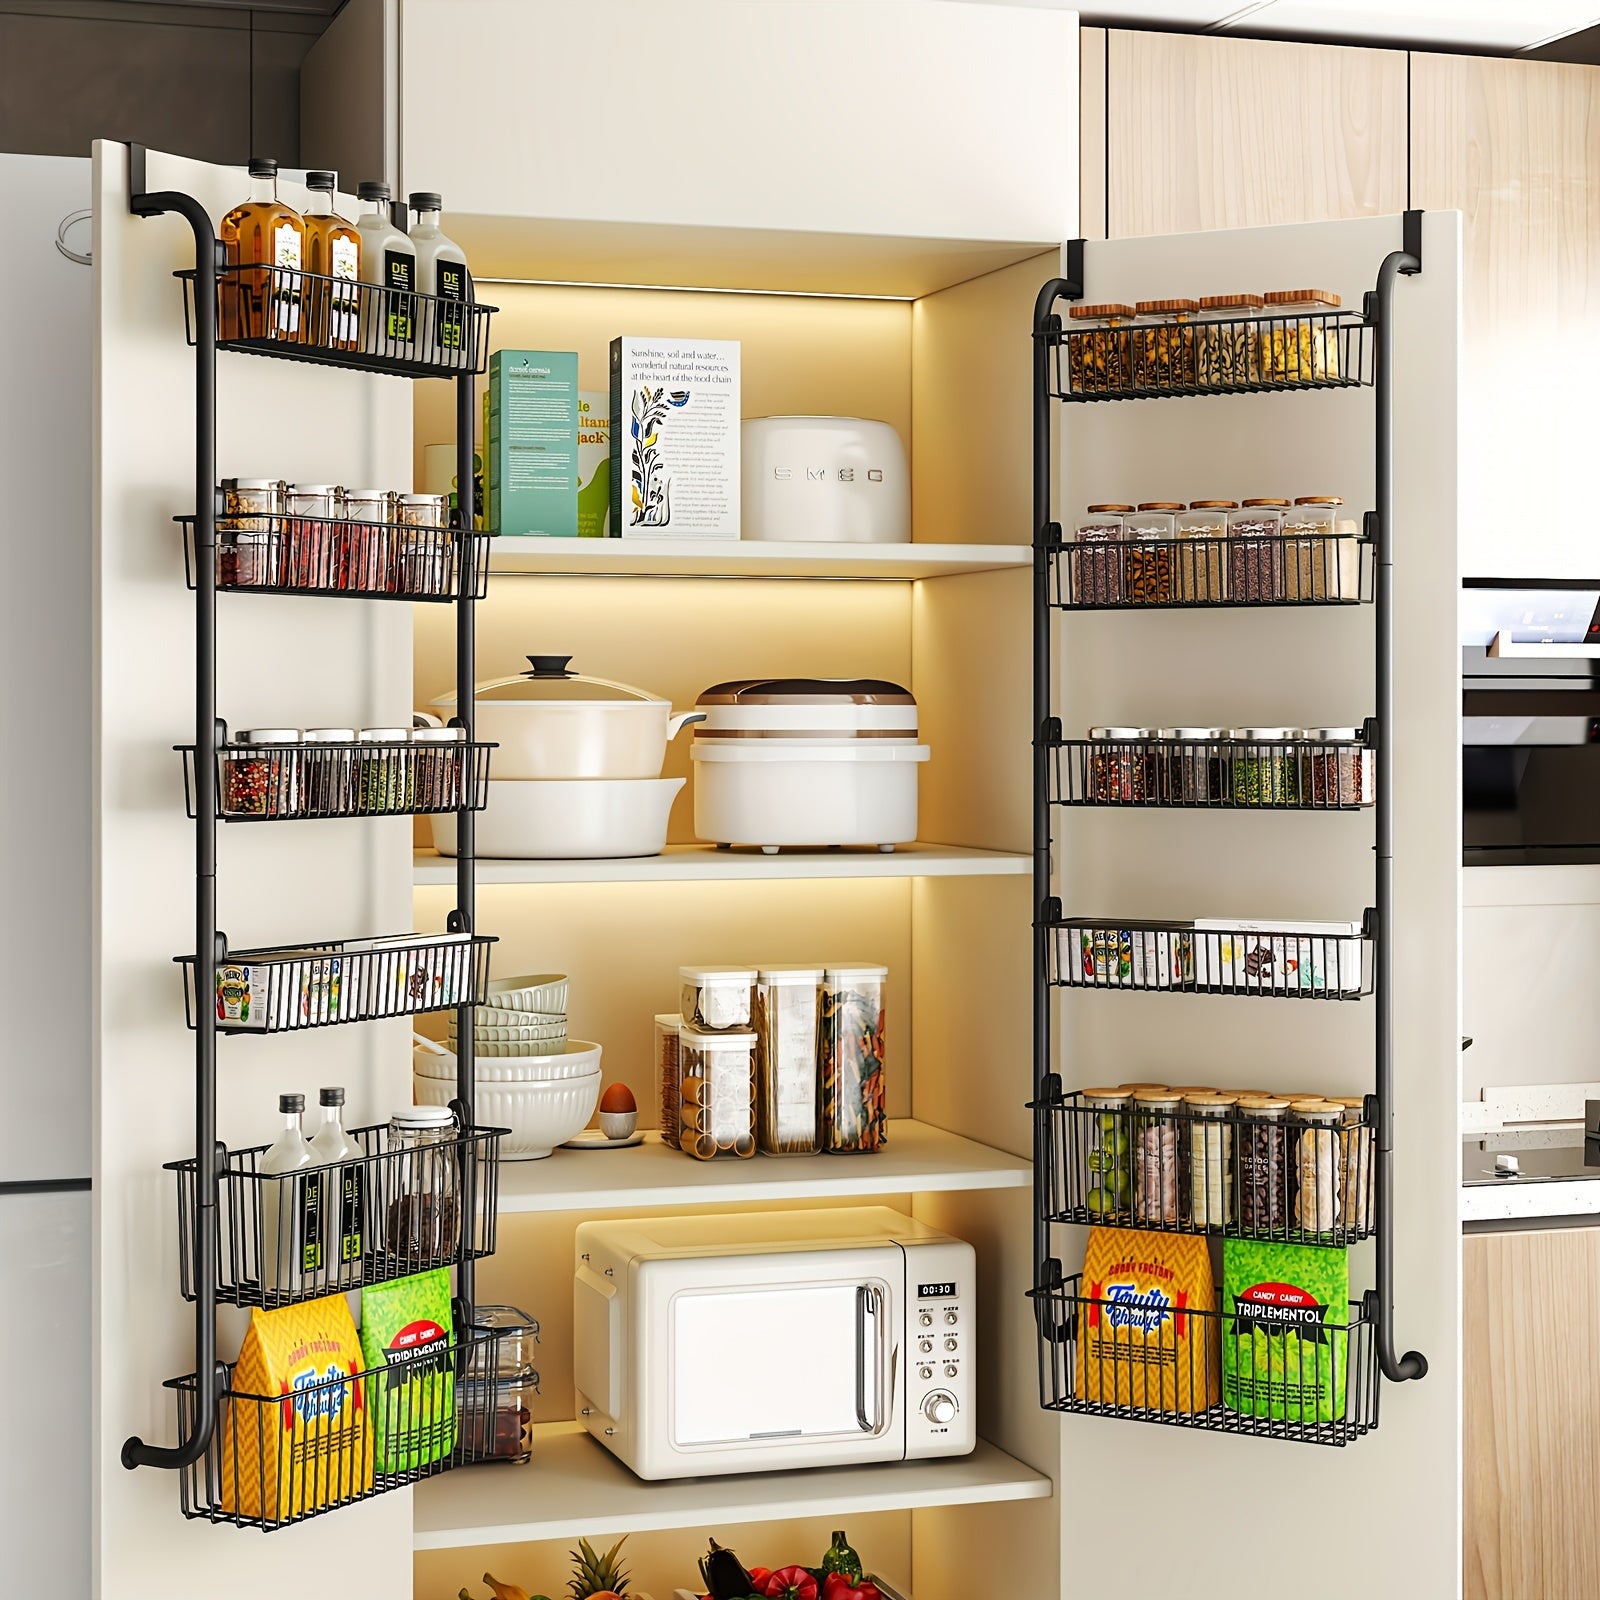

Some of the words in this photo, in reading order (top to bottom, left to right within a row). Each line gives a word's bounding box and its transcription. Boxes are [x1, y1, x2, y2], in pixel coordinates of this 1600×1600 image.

[392, 262, 408, 275] DE
[443, 271, 459, 284] DE
[631, 348, 665, 359] Sunshine,
[667, 349, 680, 358] soil
[681, 350, 696, 359] and
[631, 360, 668, 370] wonderful
[669, 361, 694, 371] natural
[639, 372, 651, 381] the
[652, 373, 671, 381] heart
[681, 374, 693, 382] the
[694, 374, 711, 383] food
[712, 375, 732, 383] chain
[774, 467, 883, 482] SMEG
[922, 1284, 951, 1295] 00:30
[1252, 1291, 1275, 1301] CANDY
[1279, 1293, 1304, 1304] CANDY
[1236, 1302, 1322, 1324] TRIPLEMENTOL
